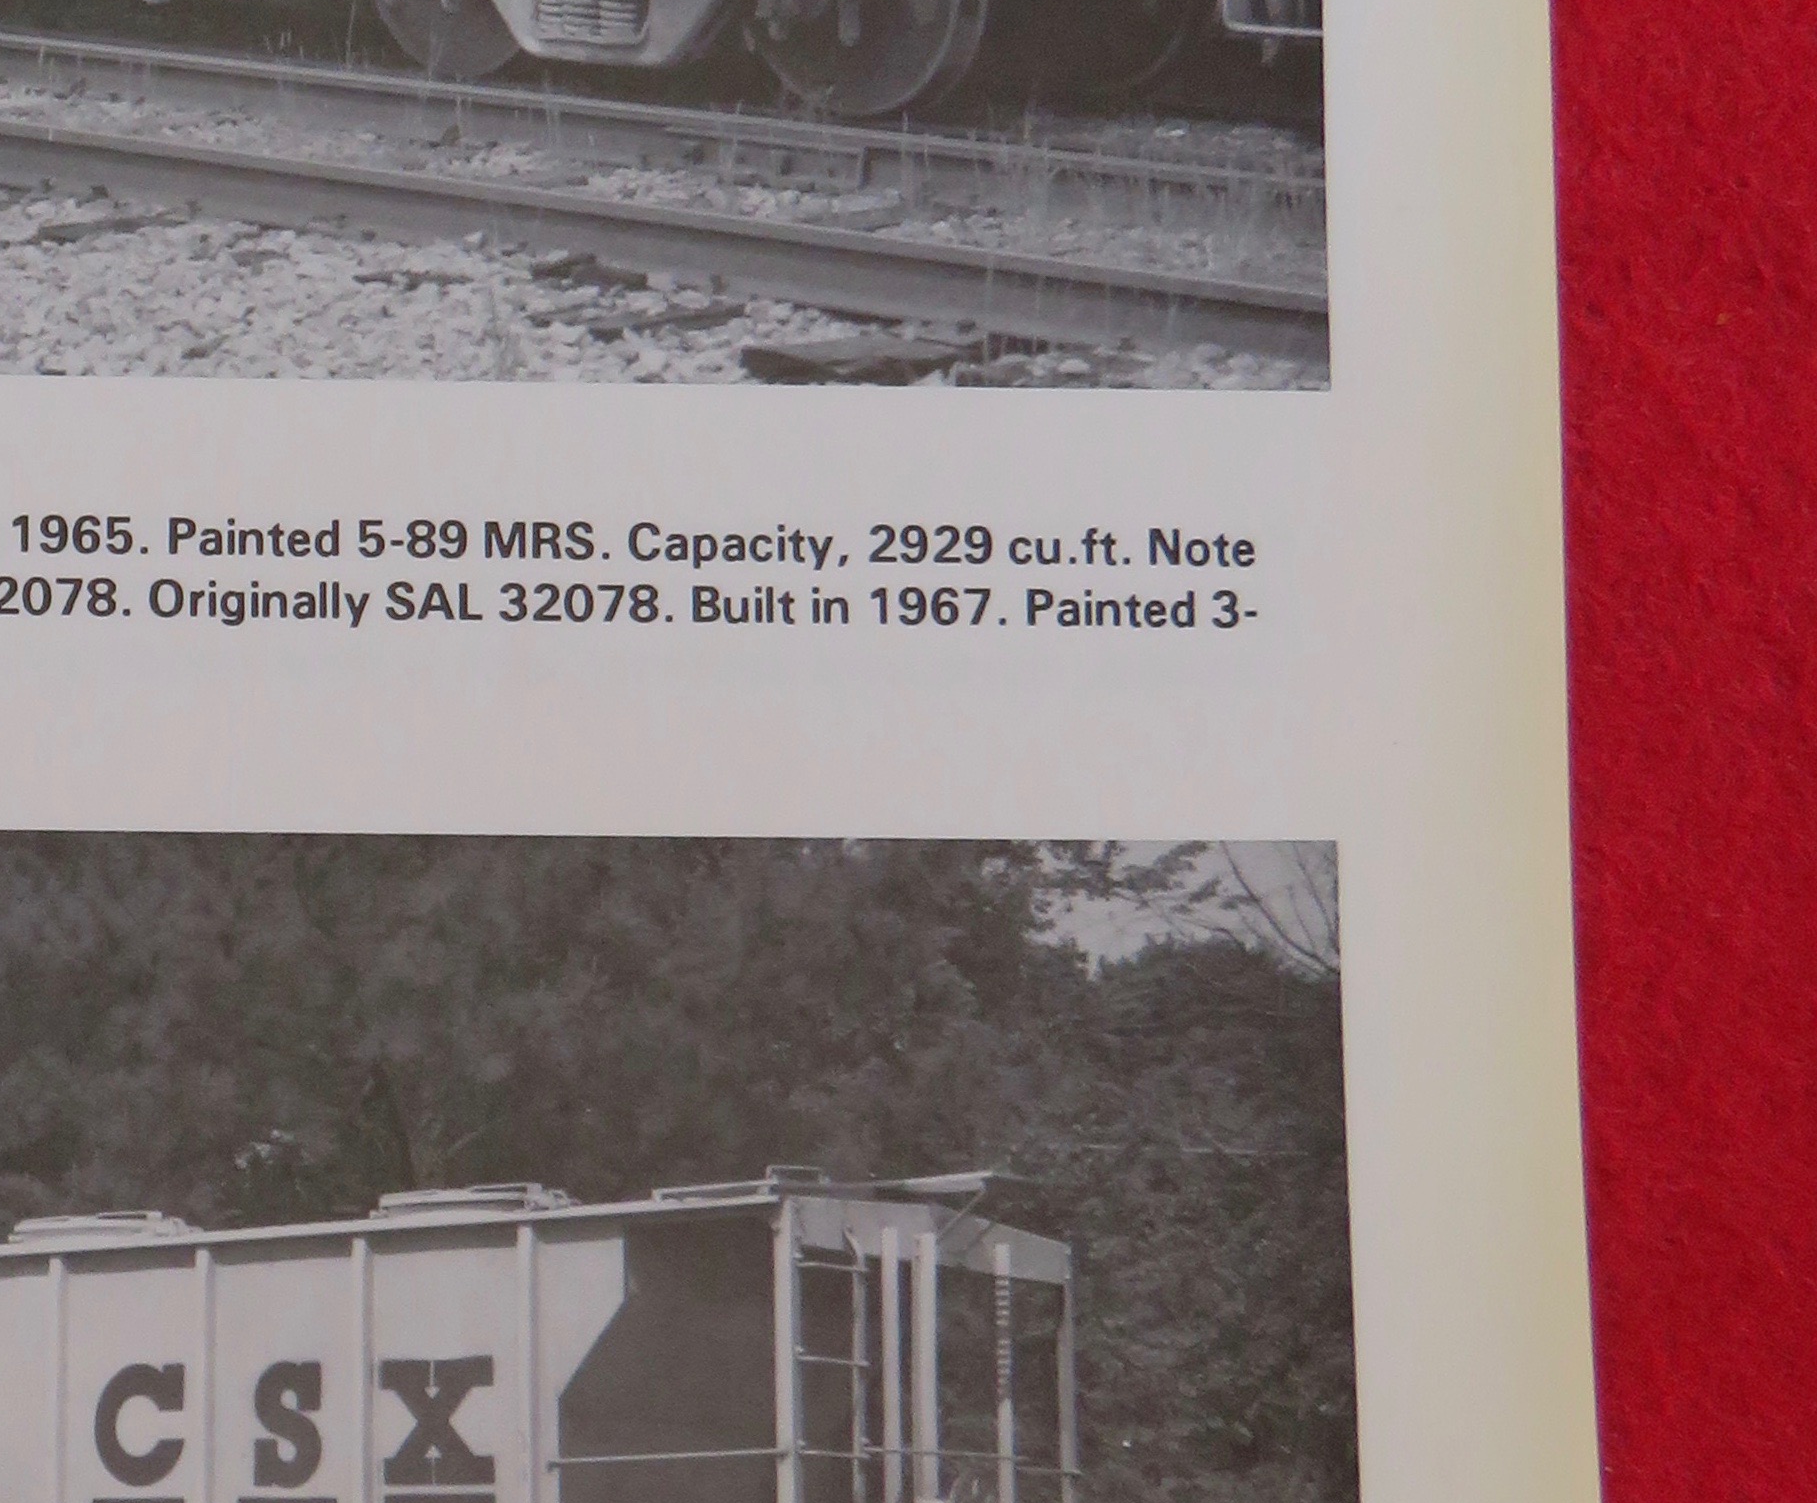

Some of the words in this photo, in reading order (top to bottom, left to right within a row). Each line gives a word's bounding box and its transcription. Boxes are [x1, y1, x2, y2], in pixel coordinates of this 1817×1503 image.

[11, 514, 149, 556] 1965.
[168, 516, 340, 558] Painted
[358, 519, 468, 560] 5-89
[484, 520, 610, 561] MRS.
[627, 521, 849, 571] Capacity,
[868, 523, 994, 565] 2929
[1008, 527, 1131, 567] cu.ft.
[1148, 527, 1256, 568] Note
[148, 578, 371, 629] Originally
[385, 580, 484, 621] SAL
[498, 582, 674, 624] 32078.
[691, 585, 796, 625] Built
[811, 586, 850, 625] in
[870, 586, 1007, 627] 1967.
[1026, 588, 1196, 629] Painted
[1211, 589, 1258, 629] 3-
